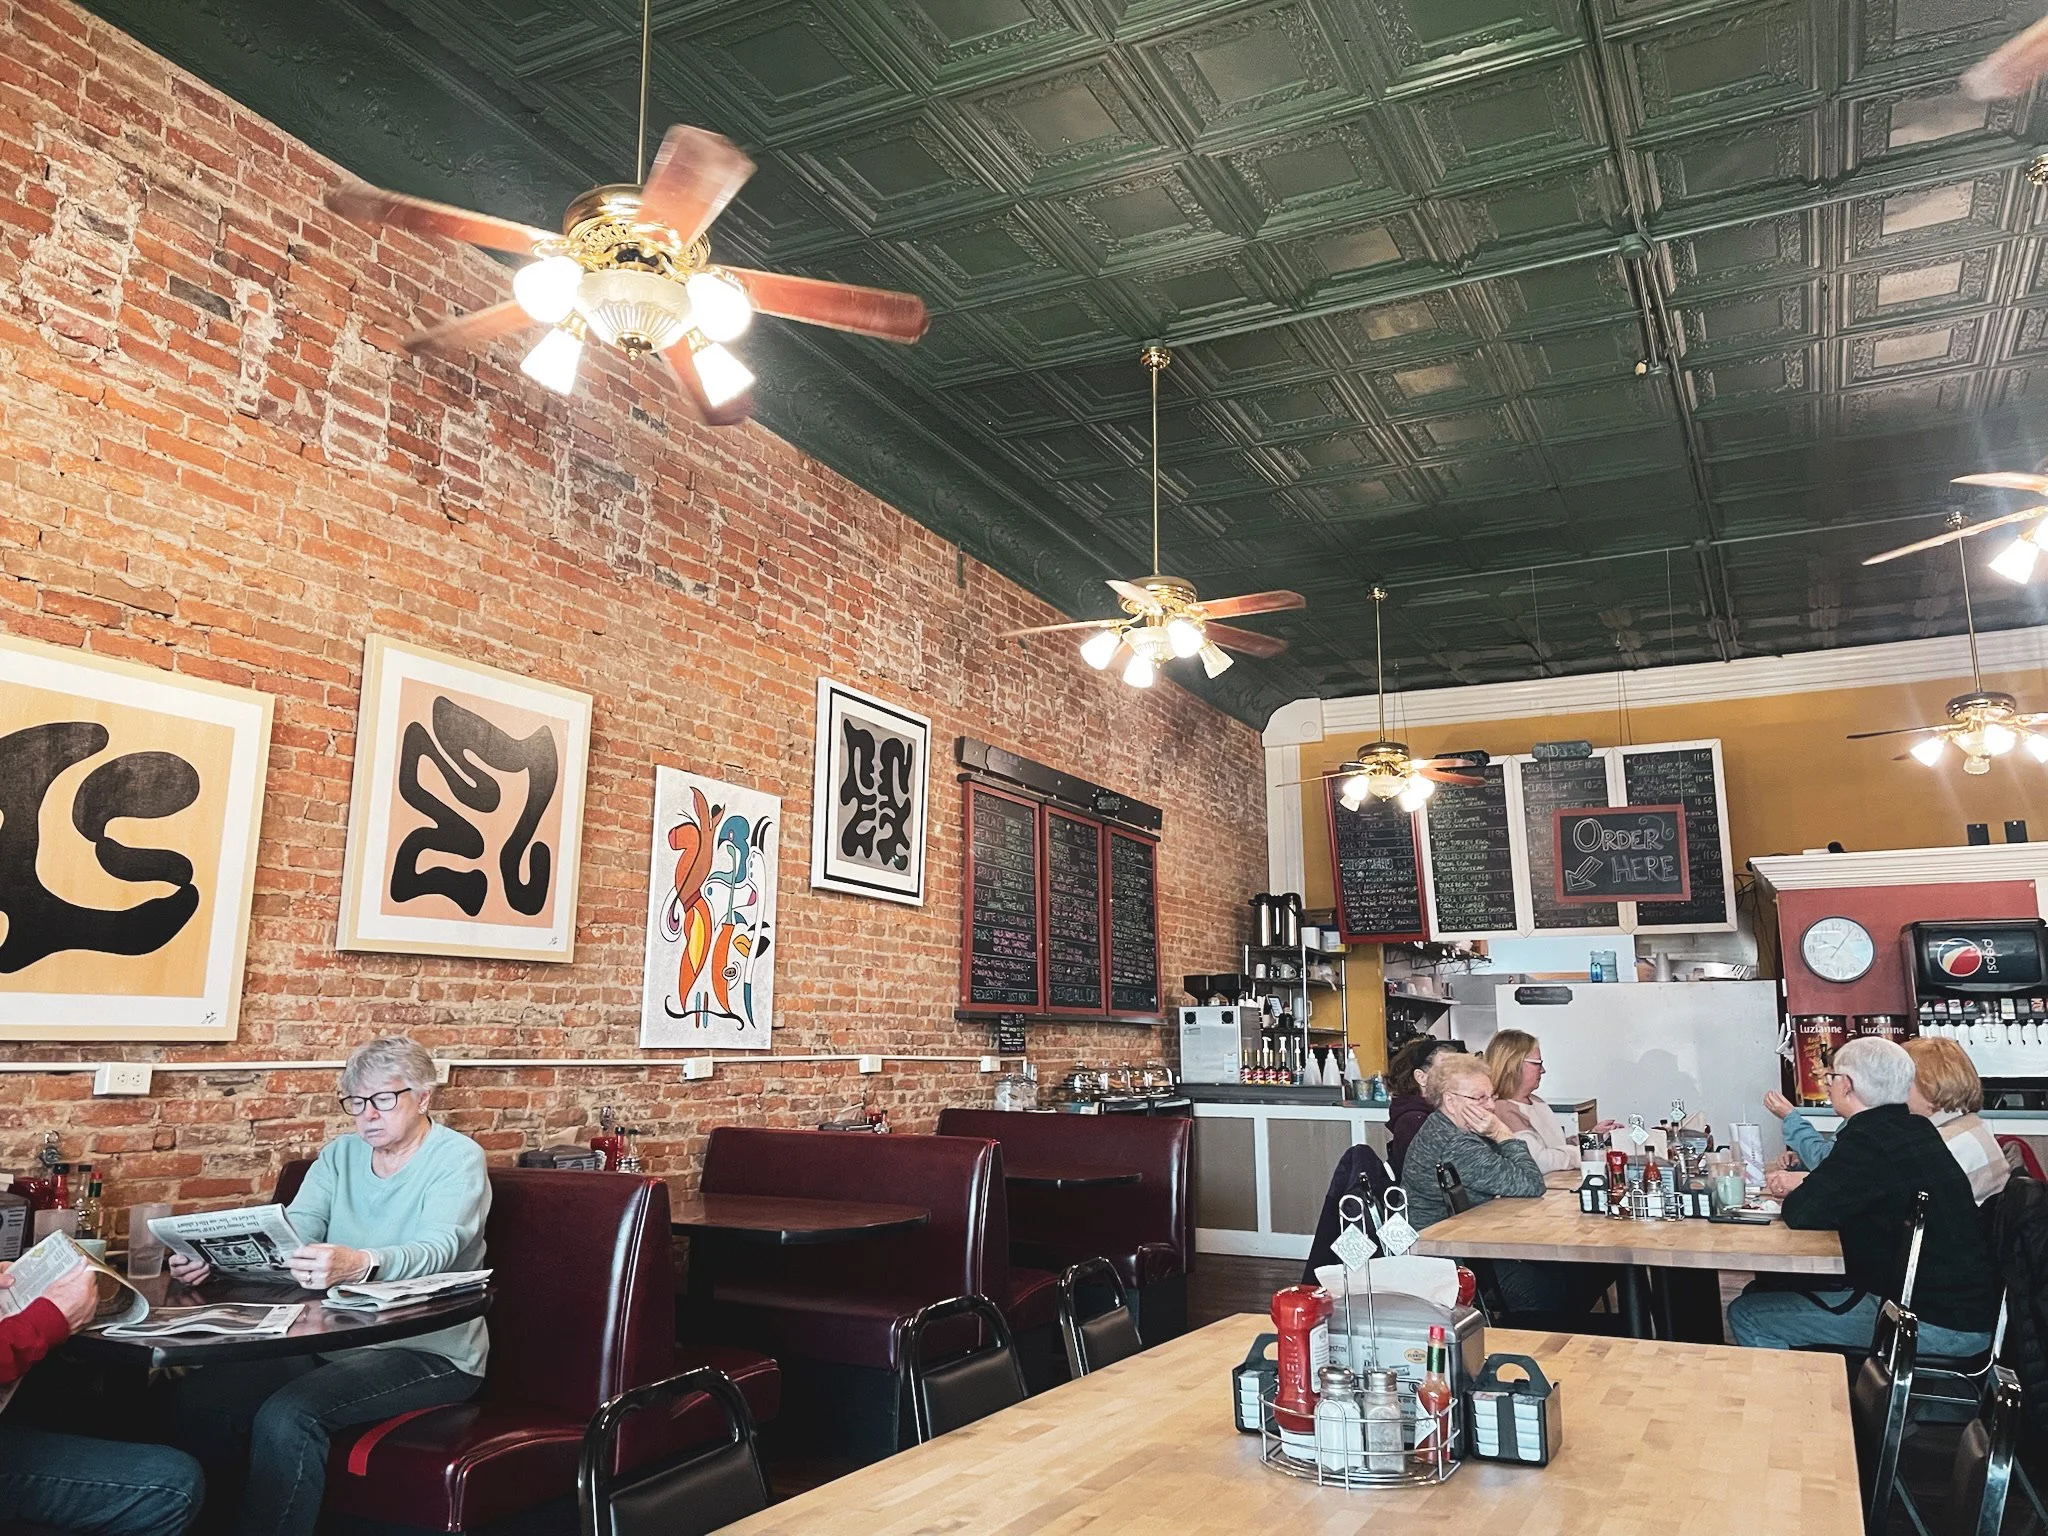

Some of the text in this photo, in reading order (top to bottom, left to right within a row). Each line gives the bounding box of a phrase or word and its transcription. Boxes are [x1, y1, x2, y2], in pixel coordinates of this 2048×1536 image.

[1573, 818, 1664, 854] ORDER
[1611, 854, 1679, 884] HERE
[1982, 938, 1999, 974] pepsi
[1800, 1024, 1843, 1034] Luzianne
[1861, 1025, 1905, 1035] Luzianne
